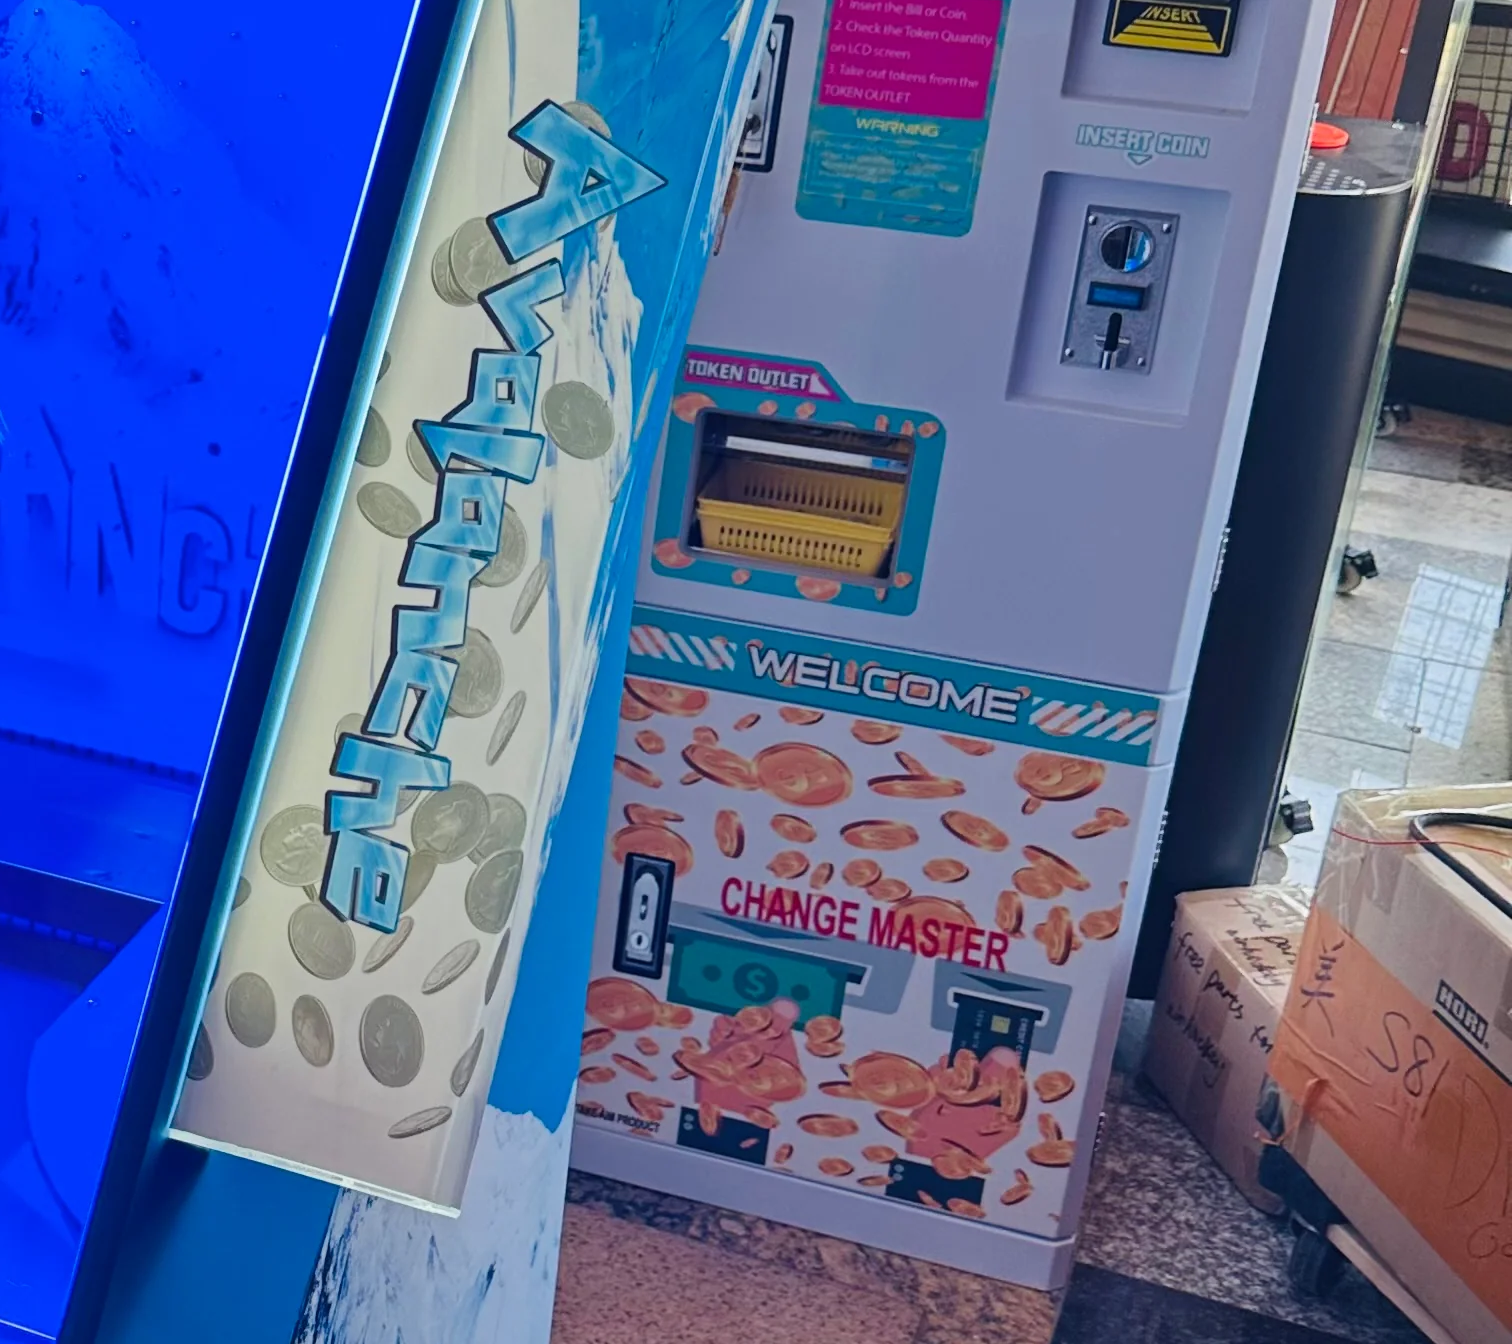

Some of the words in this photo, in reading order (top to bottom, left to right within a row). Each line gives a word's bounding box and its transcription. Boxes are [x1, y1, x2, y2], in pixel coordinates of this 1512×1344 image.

[849, 0, 882, 14] Insert
[884, 2, 903, 16] the
[905, 3, 924, 17] Bill
[924, 6, 938, 17] or
[1140, 5, 1201, 24] INSERT
[845, 21, 882, 35] Check
[884, 24, 903, 37] the
[904, 25, 939, 41] Token
[941, 30, 994, 48] Quantity
[830, 44, 846, 54] on
[848, 42, 873, 56] LCD
[874, 46, 911, 60] screen
[839, 63, 865, 77] Take
[866, 66, 887, 80] out
[888, 69, 928, 84] tokens
[928, 72, 959, 87] from
[959, 75, 980, 89] the
[824, 83, 864, 100] TOKEN
[864, 86, 912, 103] OUTLET
[856, 116, 941, 138] WARNING
[1076, 124, 1155, 153] INSERT
[1155, 132, 1211, 158] COIN
[687, 358, 744, 383] TOKEN
[746, 366, 810, 391] OUTLET
[319, 98, 668, 935] Avalanche
[747, 642, 1022, 724] WELCOME
[720, 876, 861, 942] CHANGE
[868, 904, 1011, 974] MASTER
